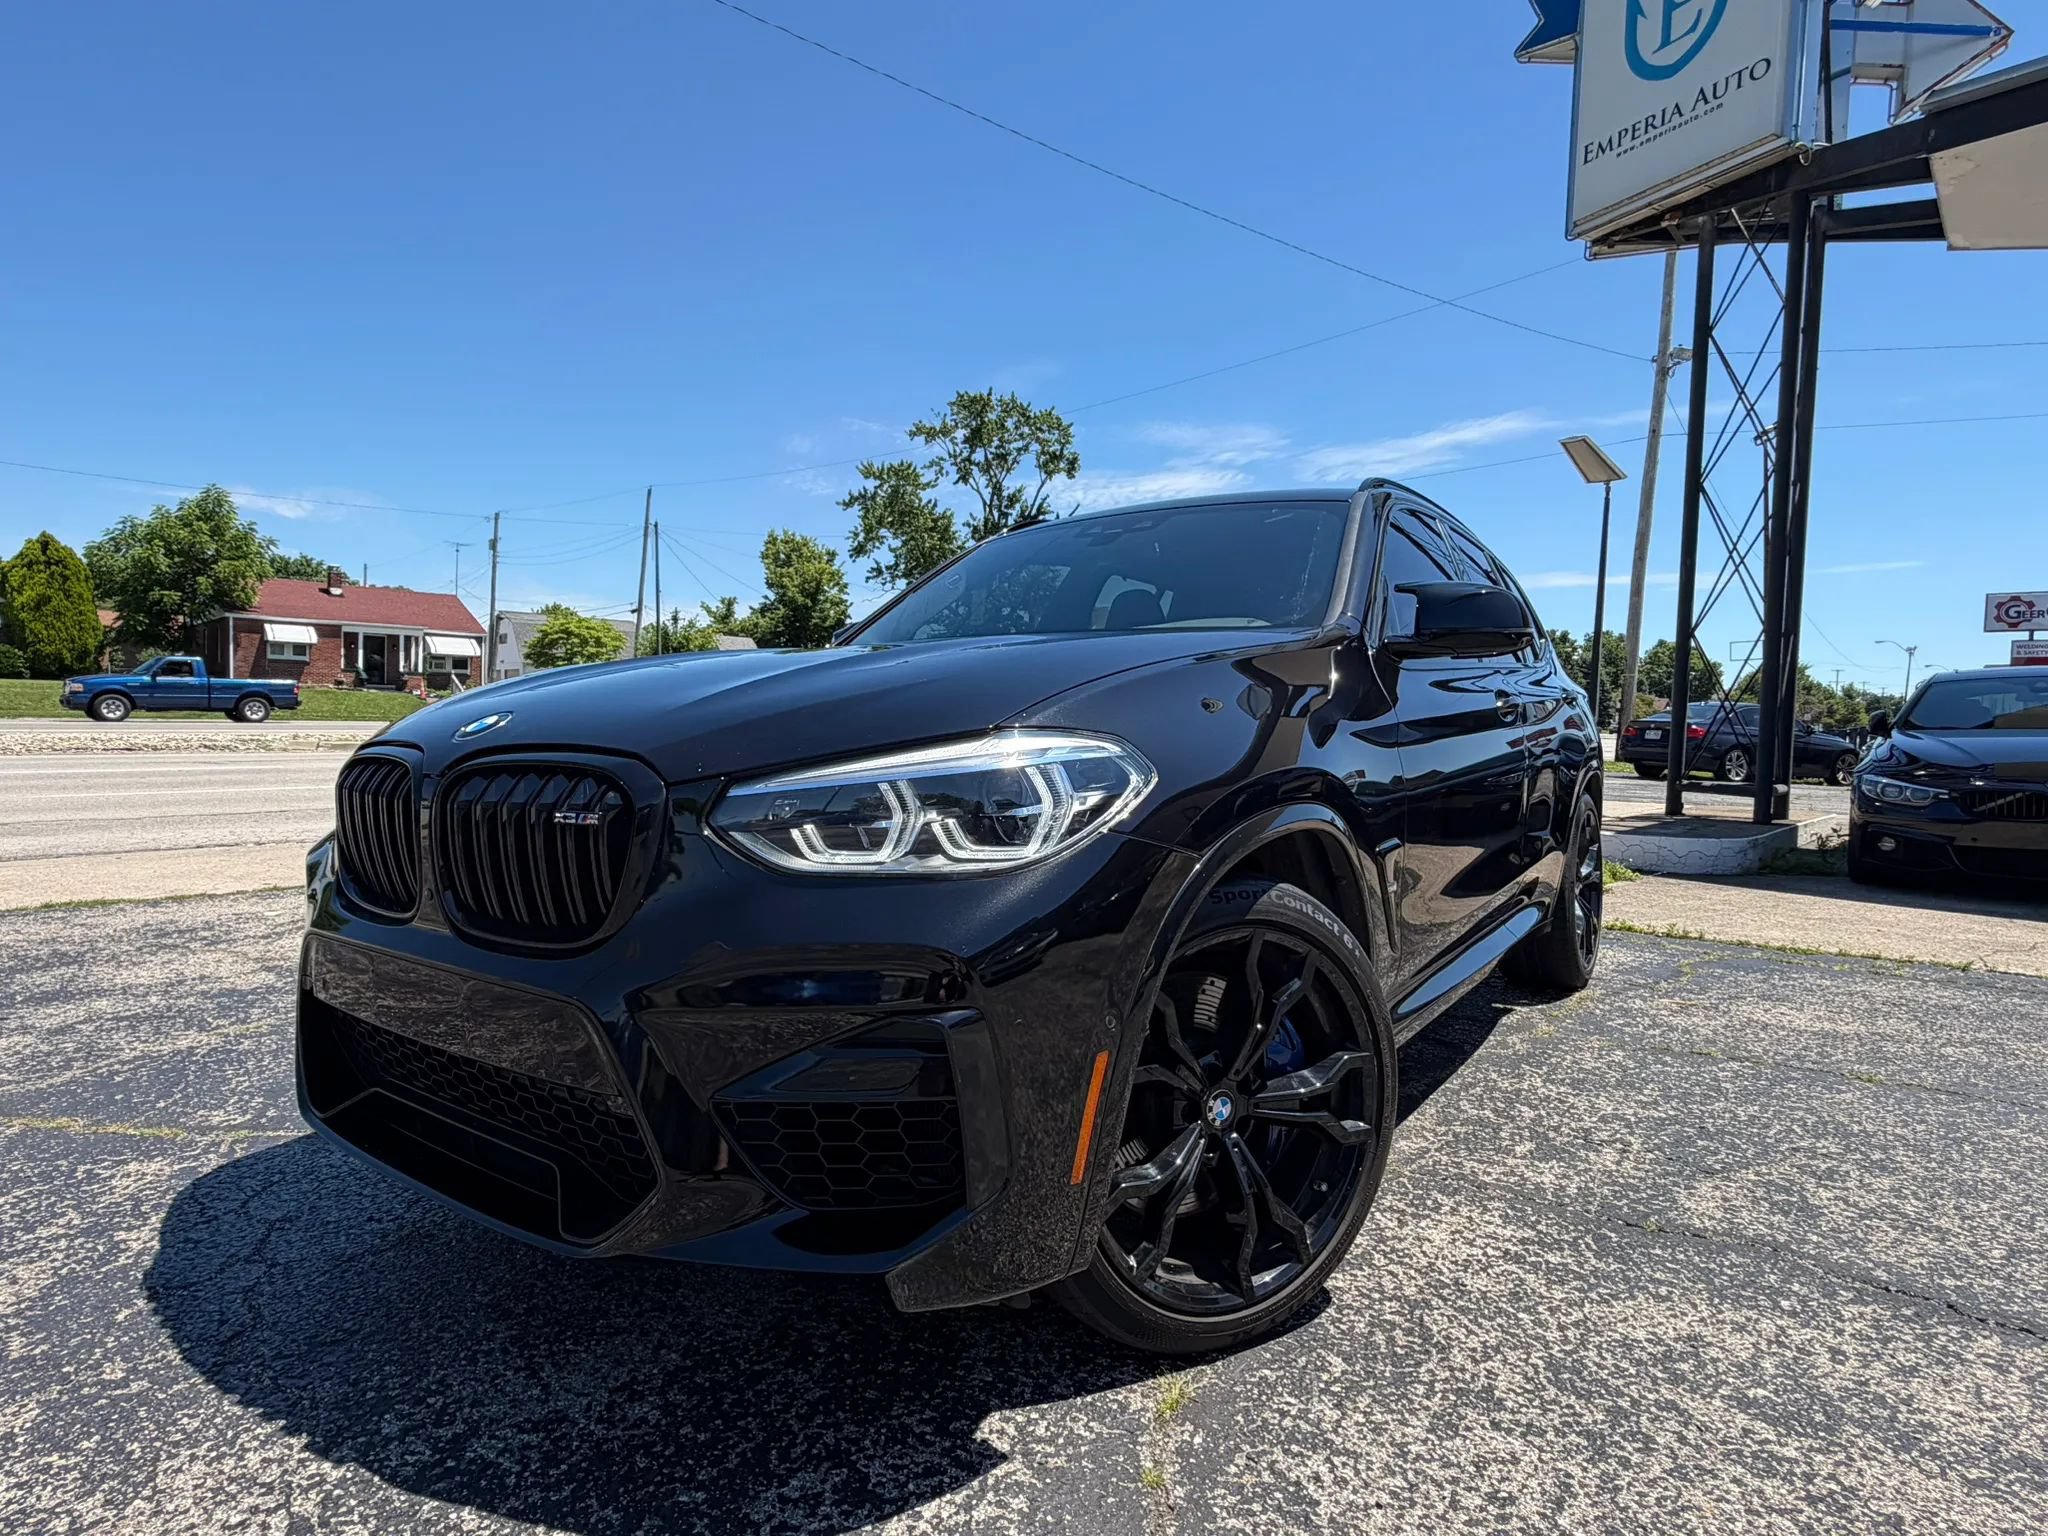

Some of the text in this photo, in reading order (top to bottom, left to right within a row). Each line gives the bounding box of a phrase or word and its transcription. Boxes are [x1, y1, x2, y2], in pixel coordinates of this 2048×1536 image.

[1583, 58, 1771, 165] EMPERIA AUTO
[1616, 102, 1724, 159] www.emperiaauto.com
